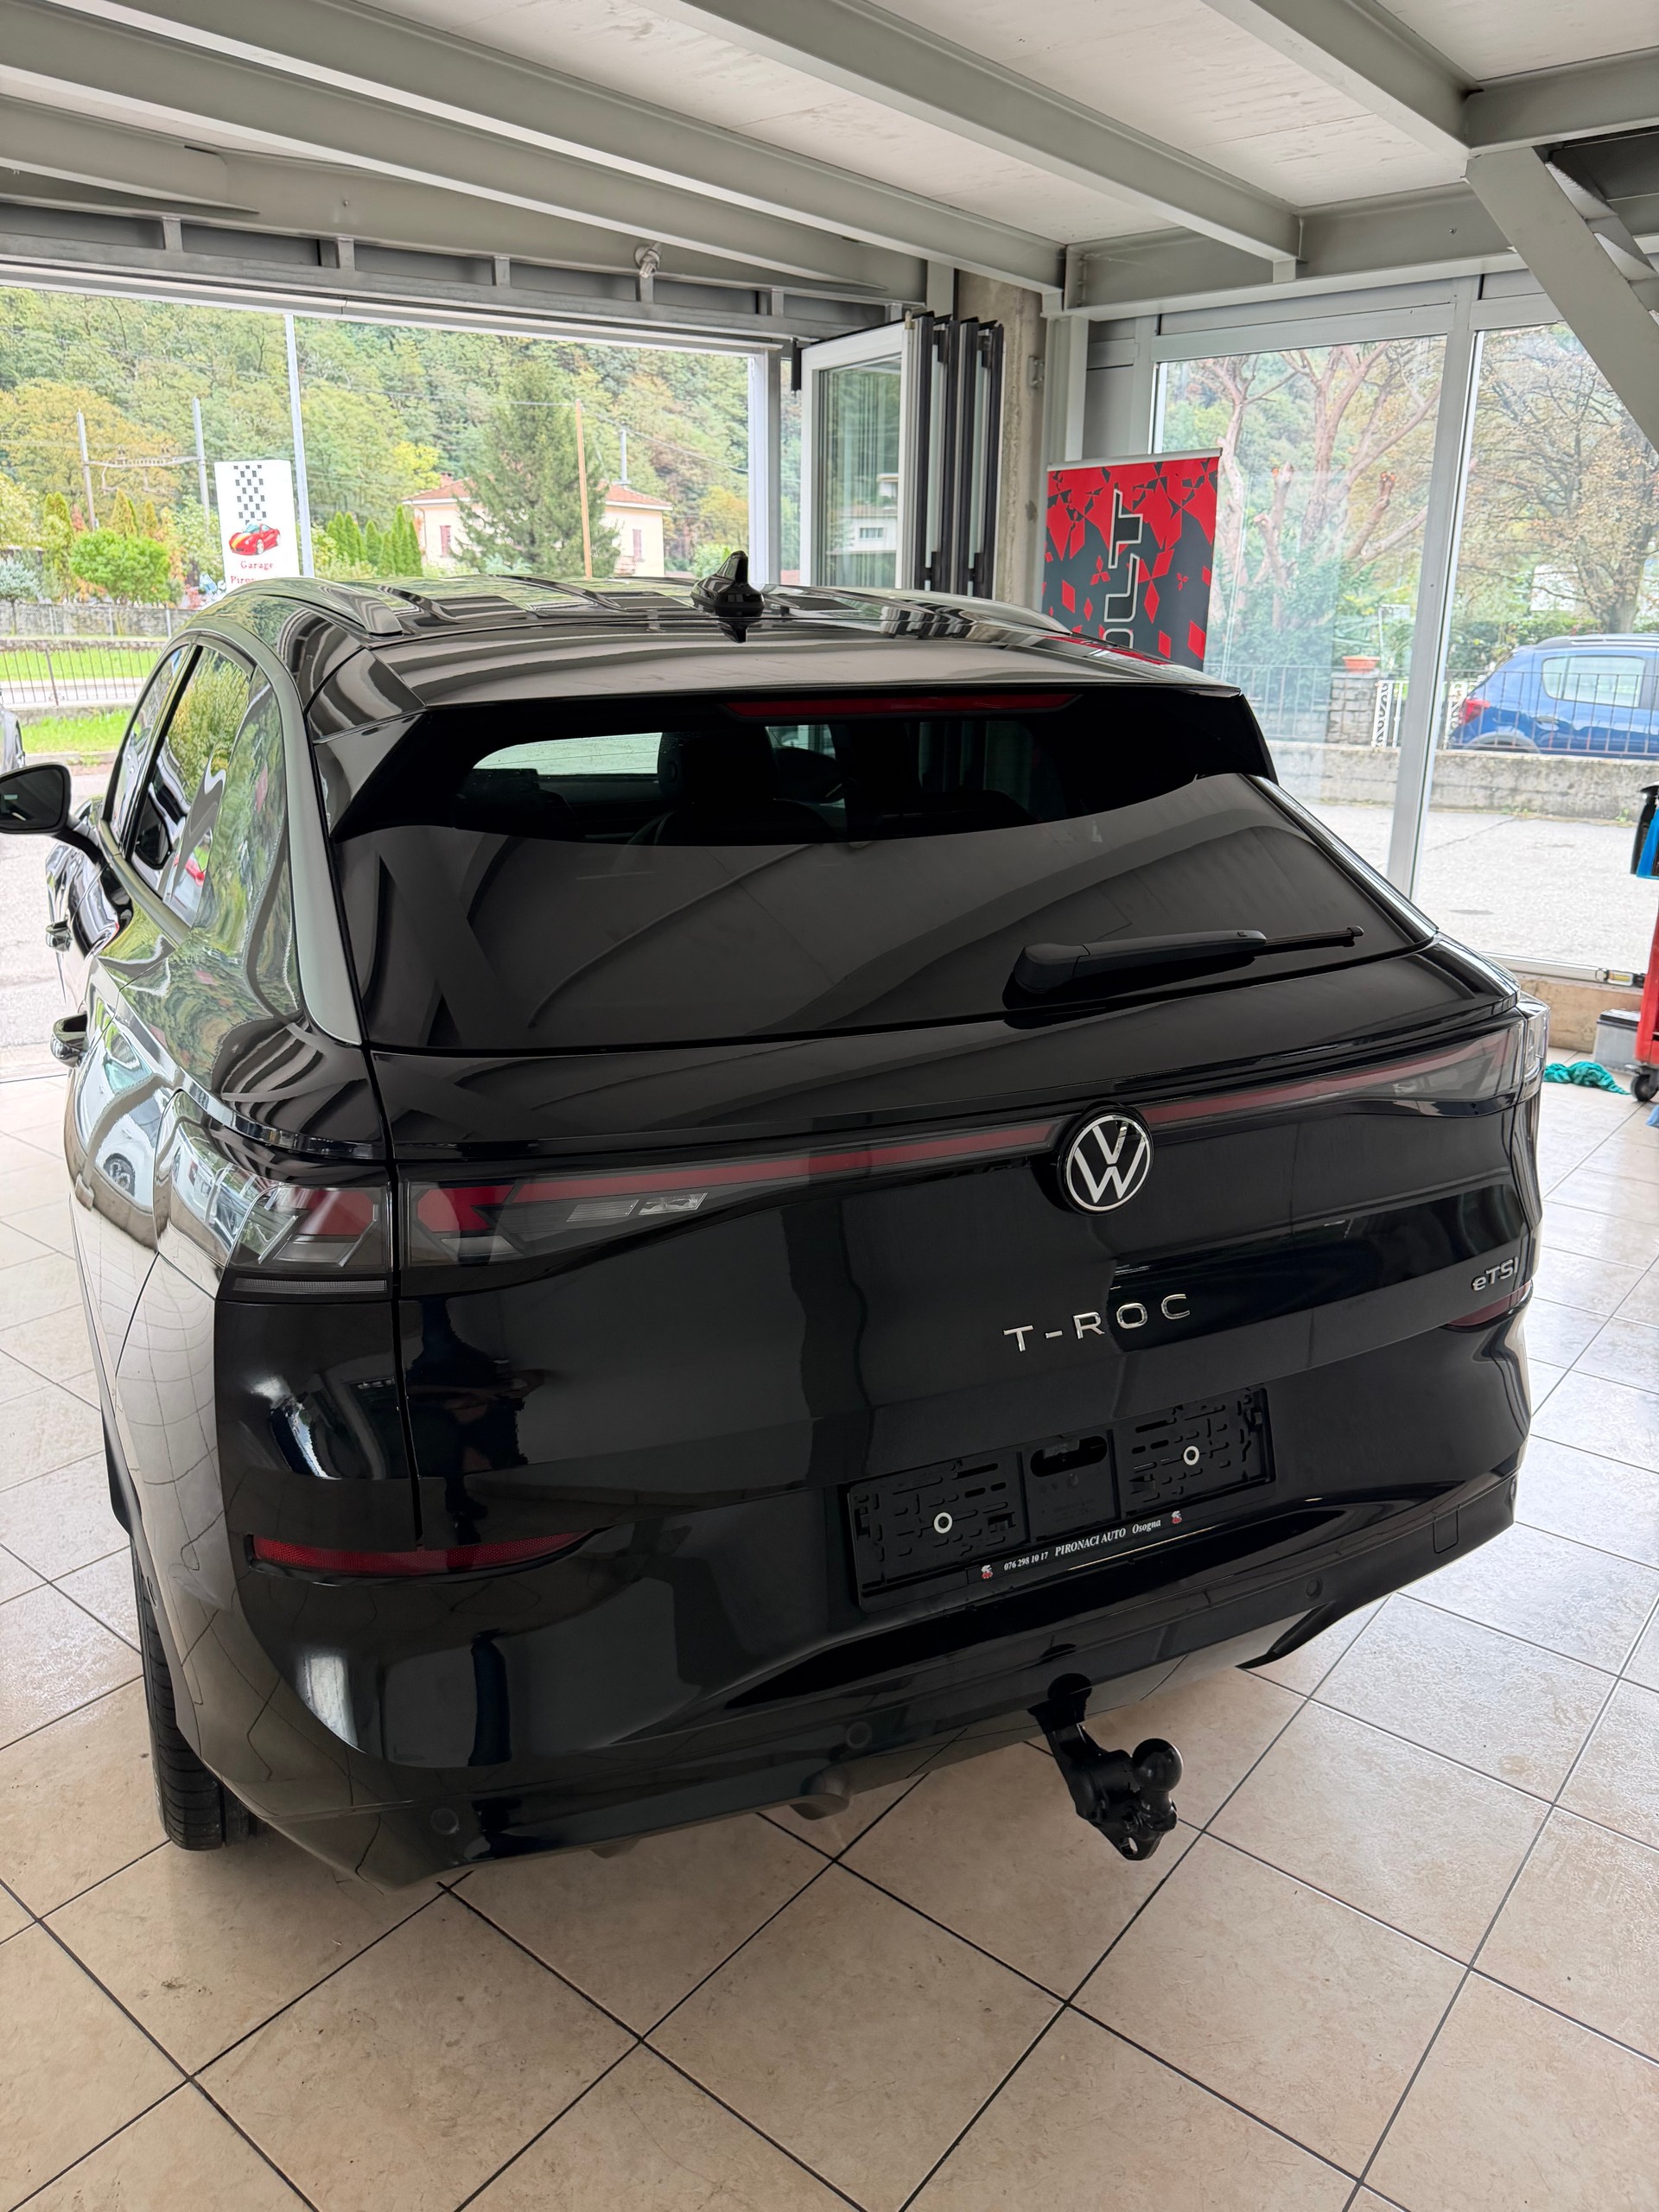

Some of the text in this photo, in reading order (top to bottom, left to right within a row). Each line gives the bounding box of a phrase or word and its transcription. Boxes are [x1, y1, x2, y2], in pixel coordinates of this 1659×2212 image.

[240, 560, 274, 570] Garage
[1066, 1115, 1150, 1211] VW
[1472, 1256, 1520, 1291] eTSI
[1002, 1294, 1191, 1352] T-ROC
[1003, 1519, 1161, 1571] 076 298 10 17 PIRONACI AUTO Osogna
